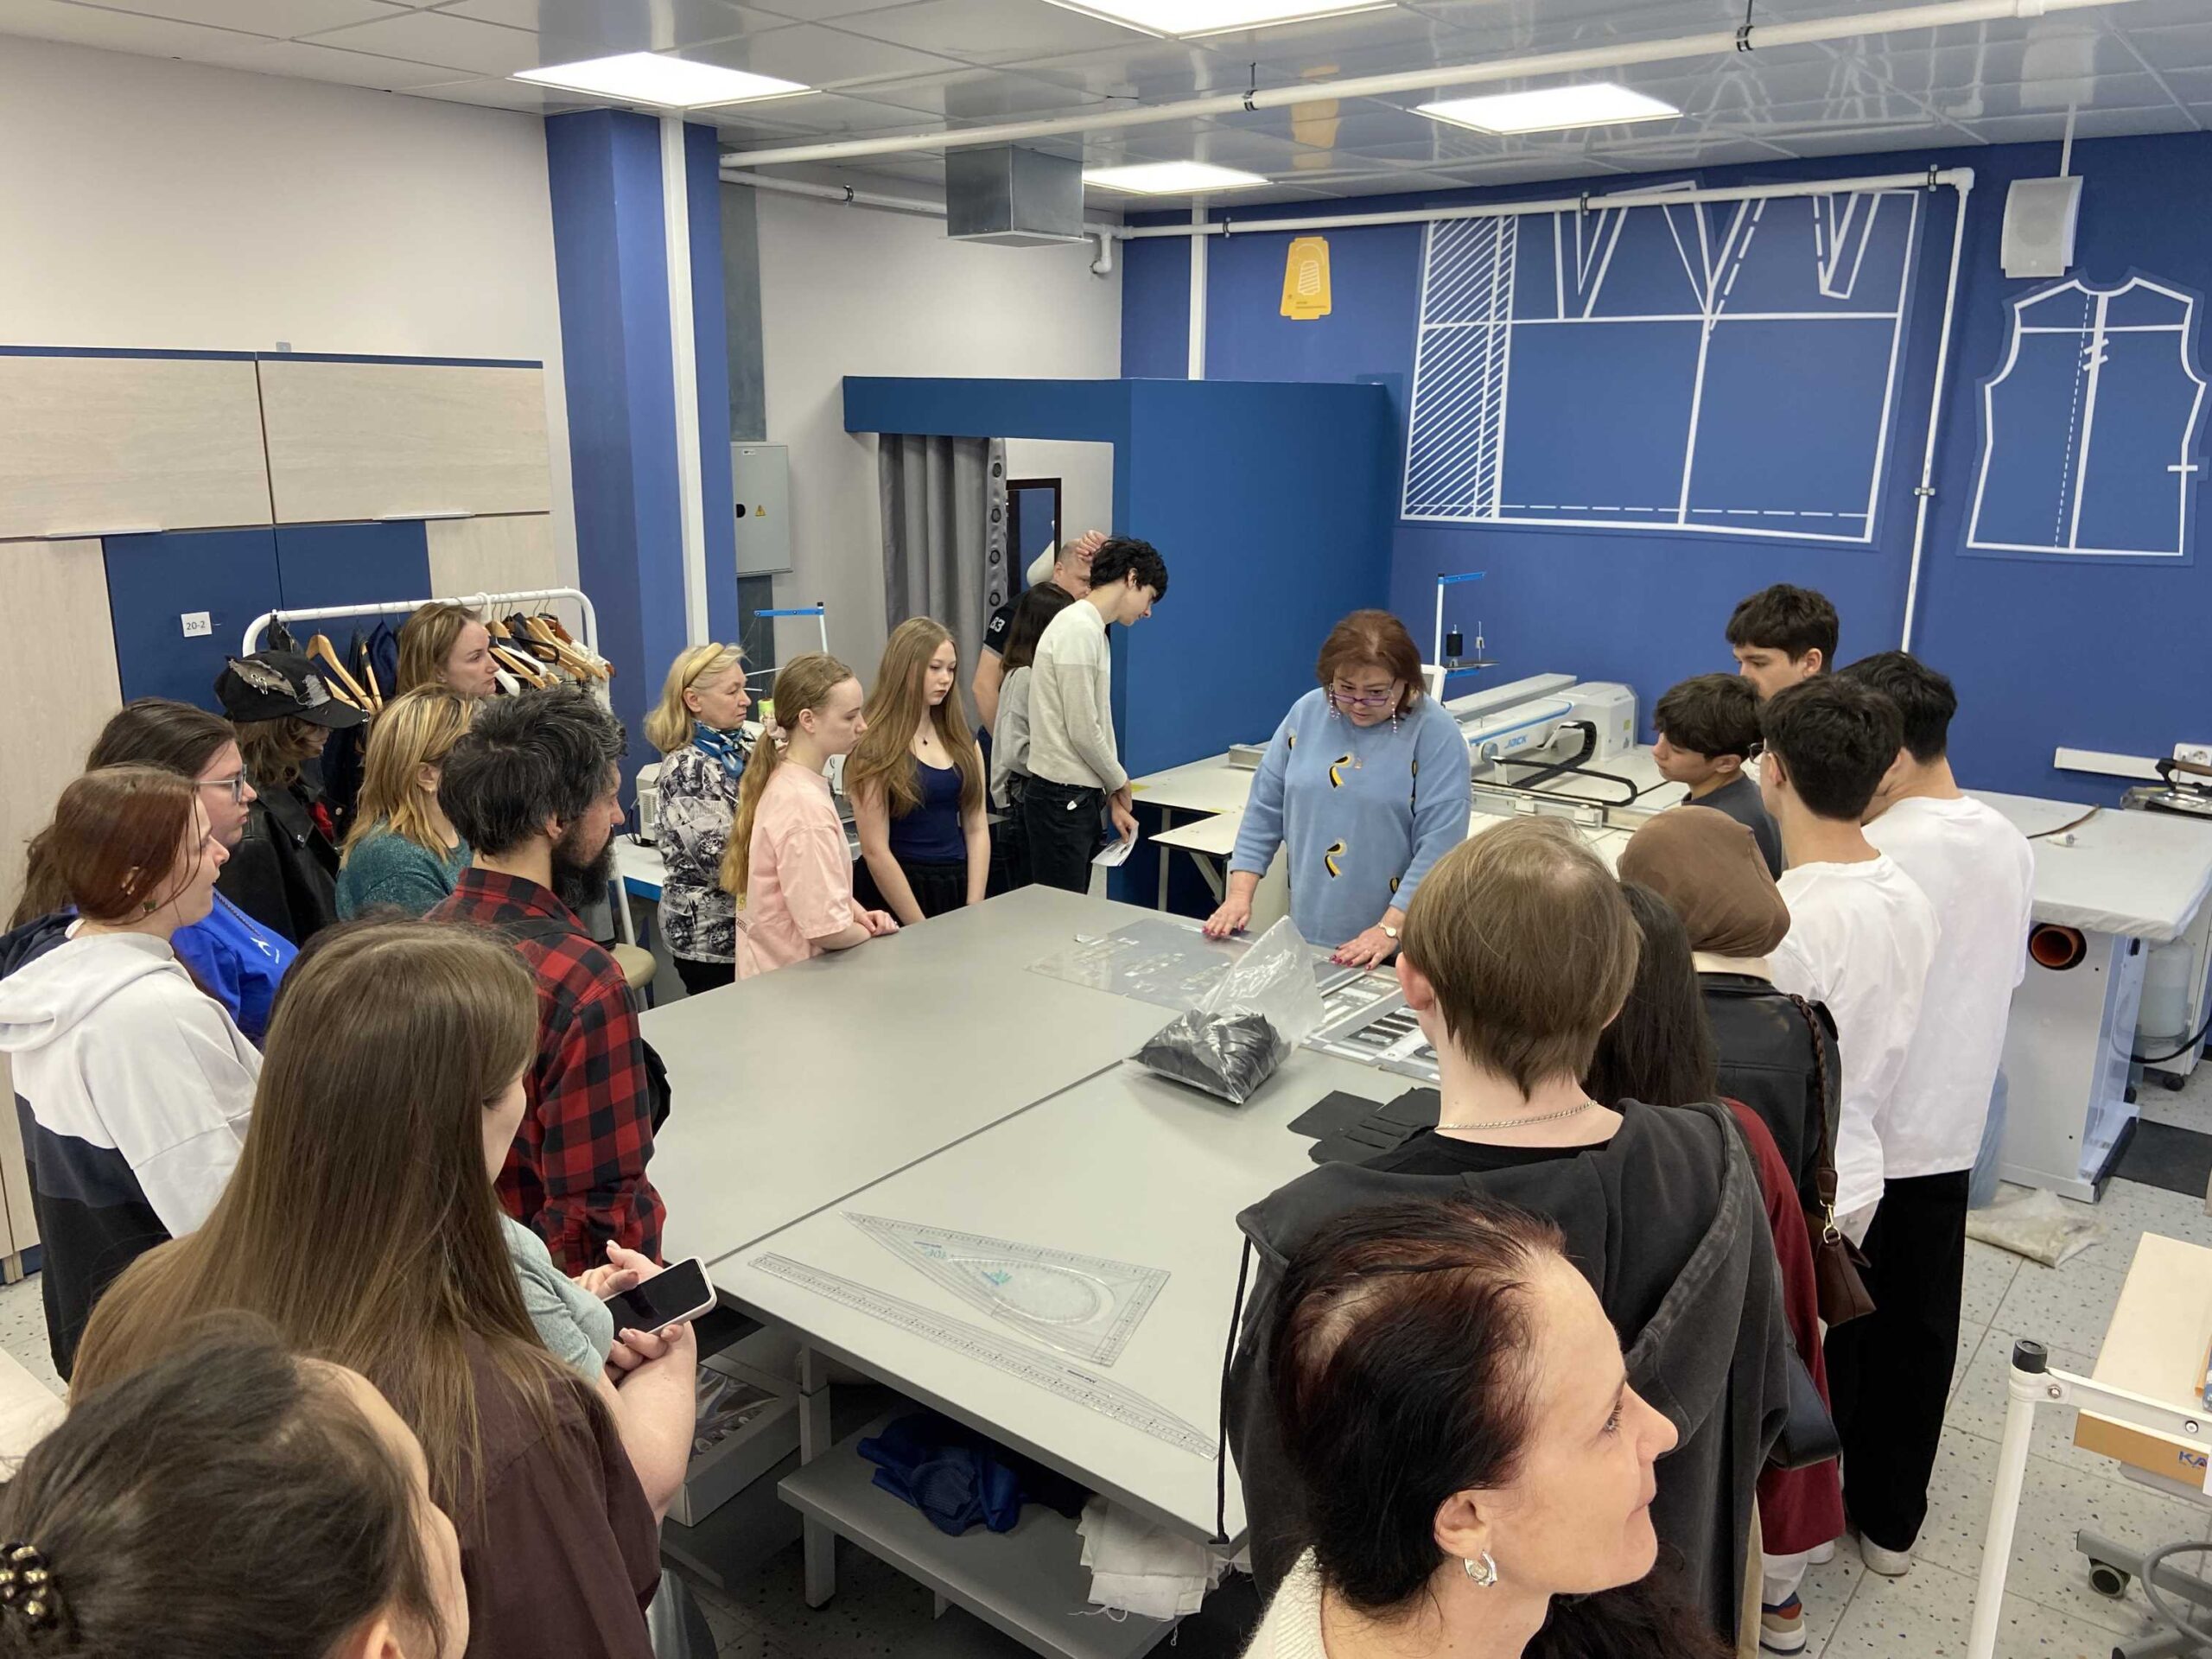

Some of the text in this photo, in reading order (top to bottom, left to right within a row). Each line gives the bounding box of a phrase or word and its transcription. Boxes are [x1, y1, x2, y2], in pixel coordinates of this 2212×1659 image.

[186, 620, 206, 631] 20-2
[989, 616, 1006, 632] 83
[1504, 735, 1528, 749] JACK
